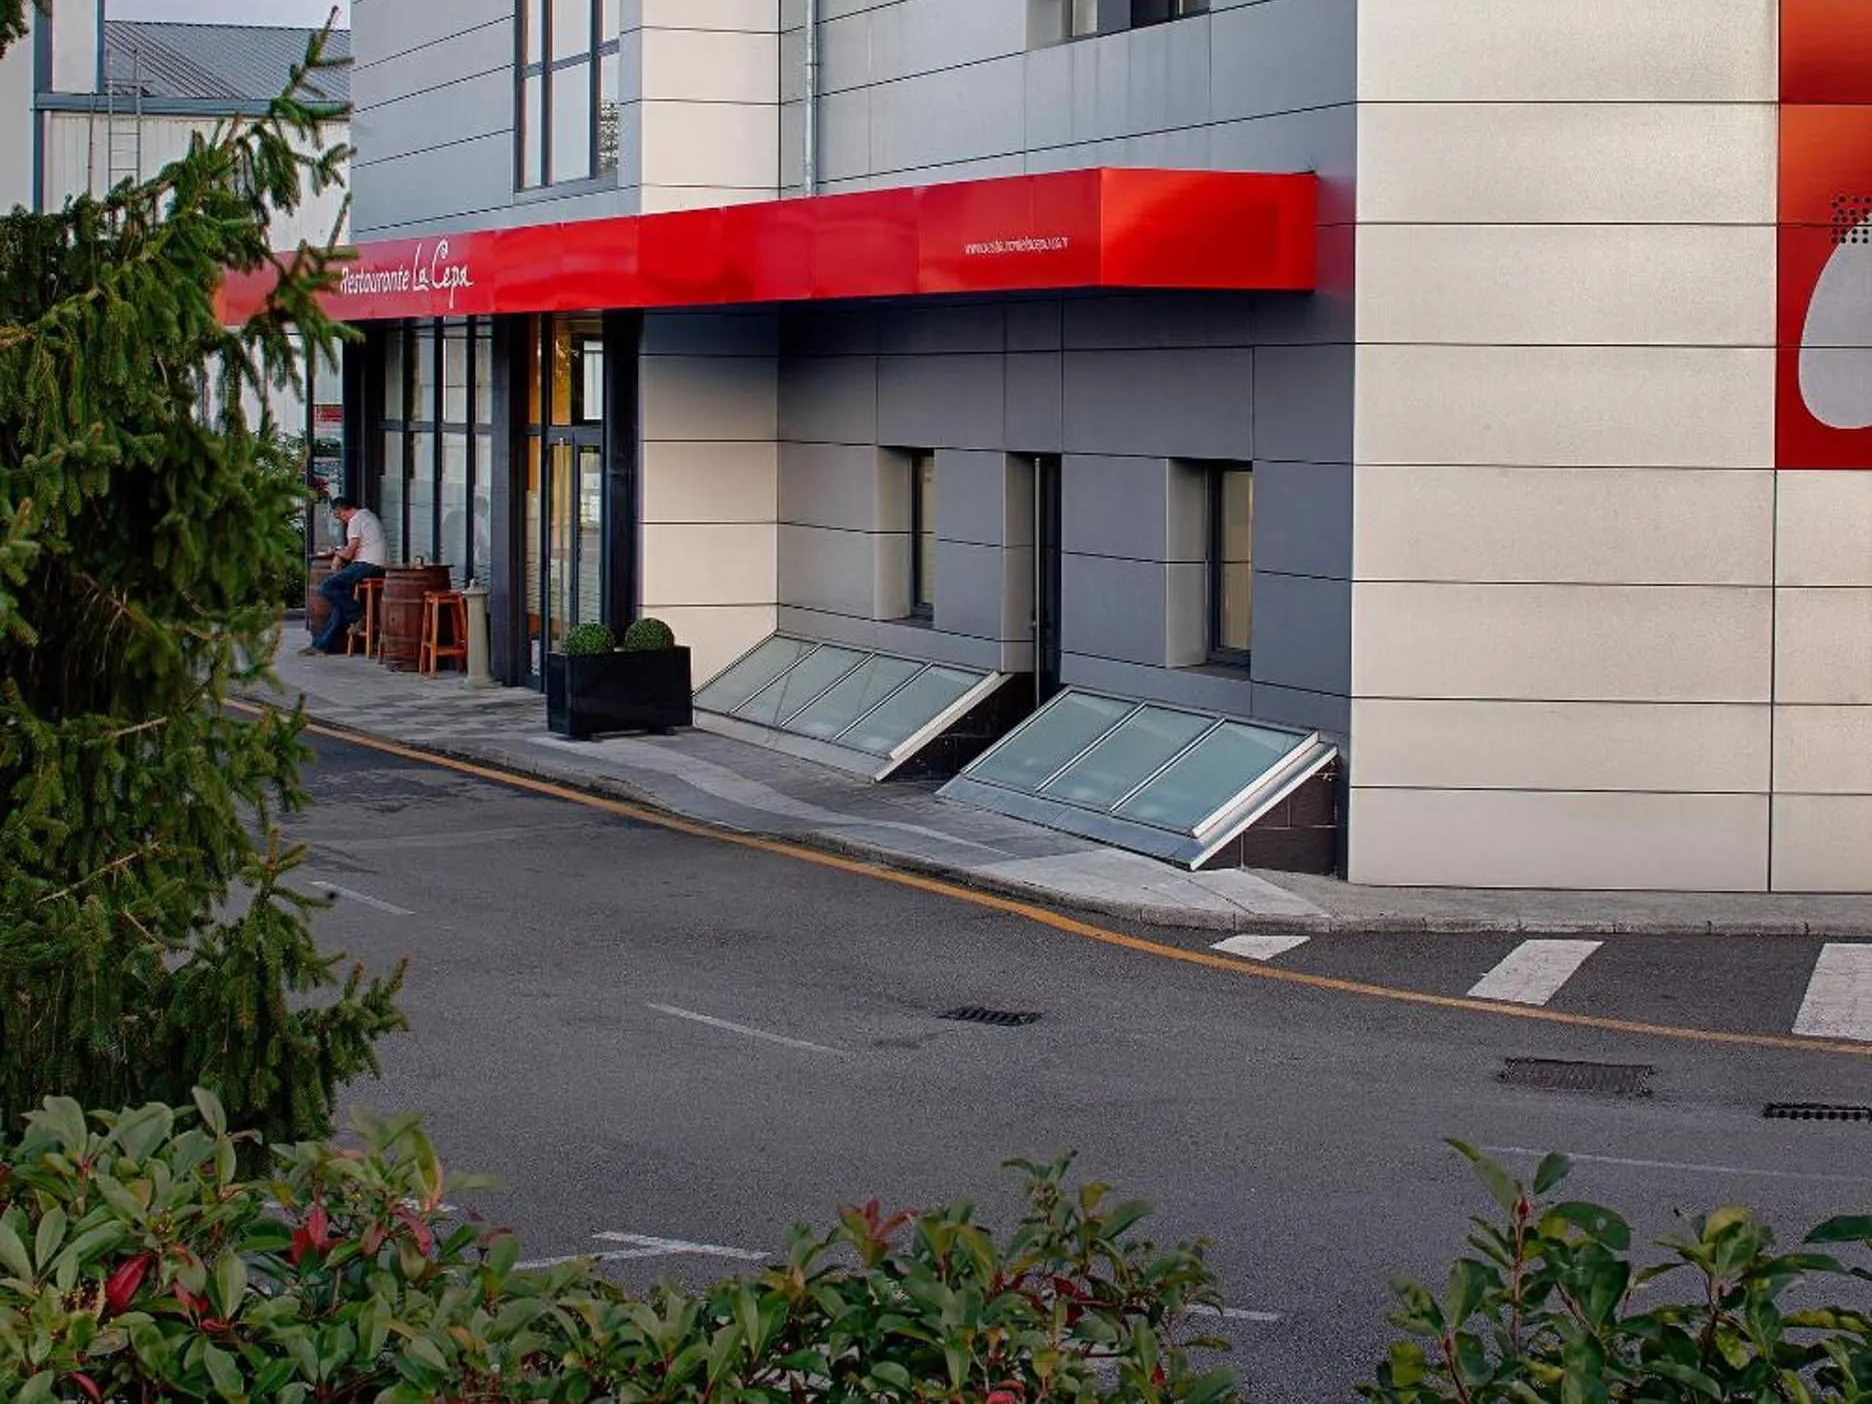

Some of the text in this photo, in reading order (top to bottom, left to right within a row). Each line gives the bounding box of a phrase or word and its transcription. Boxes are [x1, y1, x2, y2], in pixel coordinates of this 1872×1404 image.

[340, 239, 474, 309] Restaurante La Cepa
